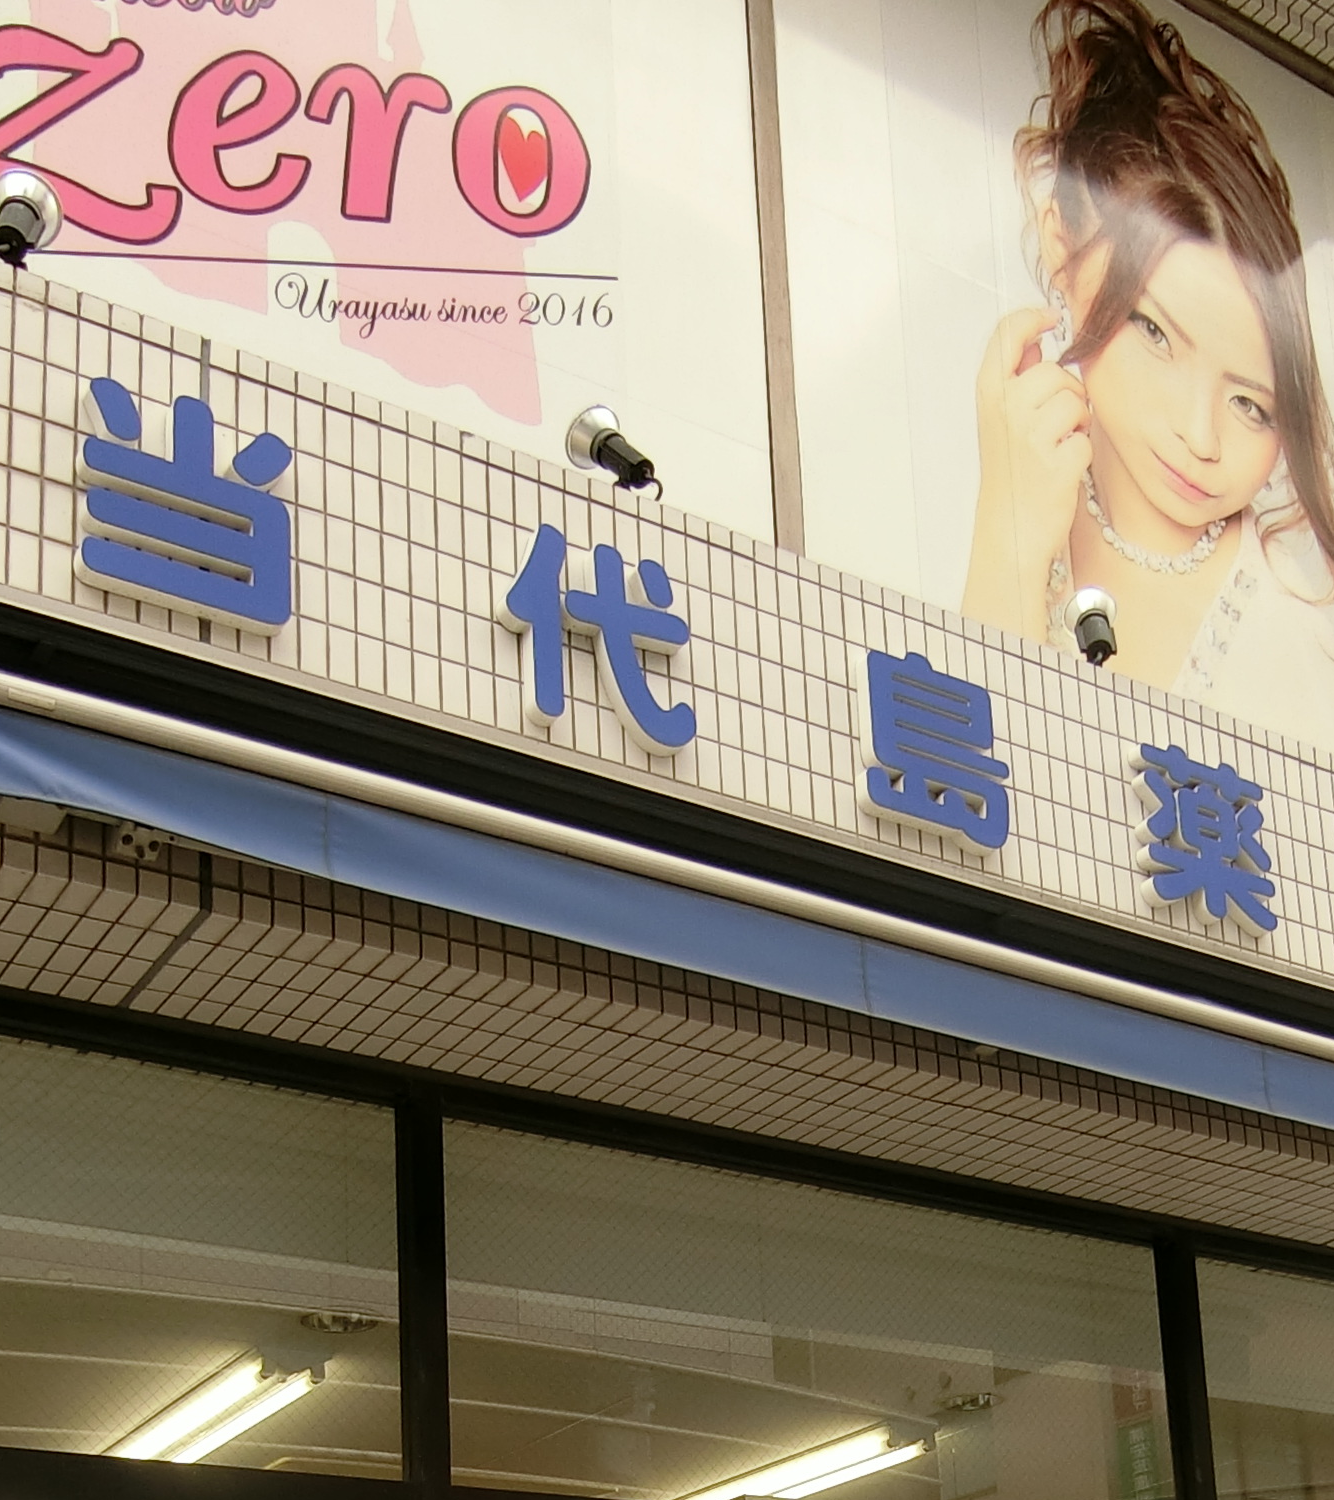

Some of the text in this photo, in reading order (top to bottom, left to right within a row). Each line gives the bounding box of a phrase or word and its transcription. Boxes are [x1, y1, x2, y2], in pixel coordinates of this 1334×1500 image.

[274, 272, 614, 339] Urayasu since 2016
